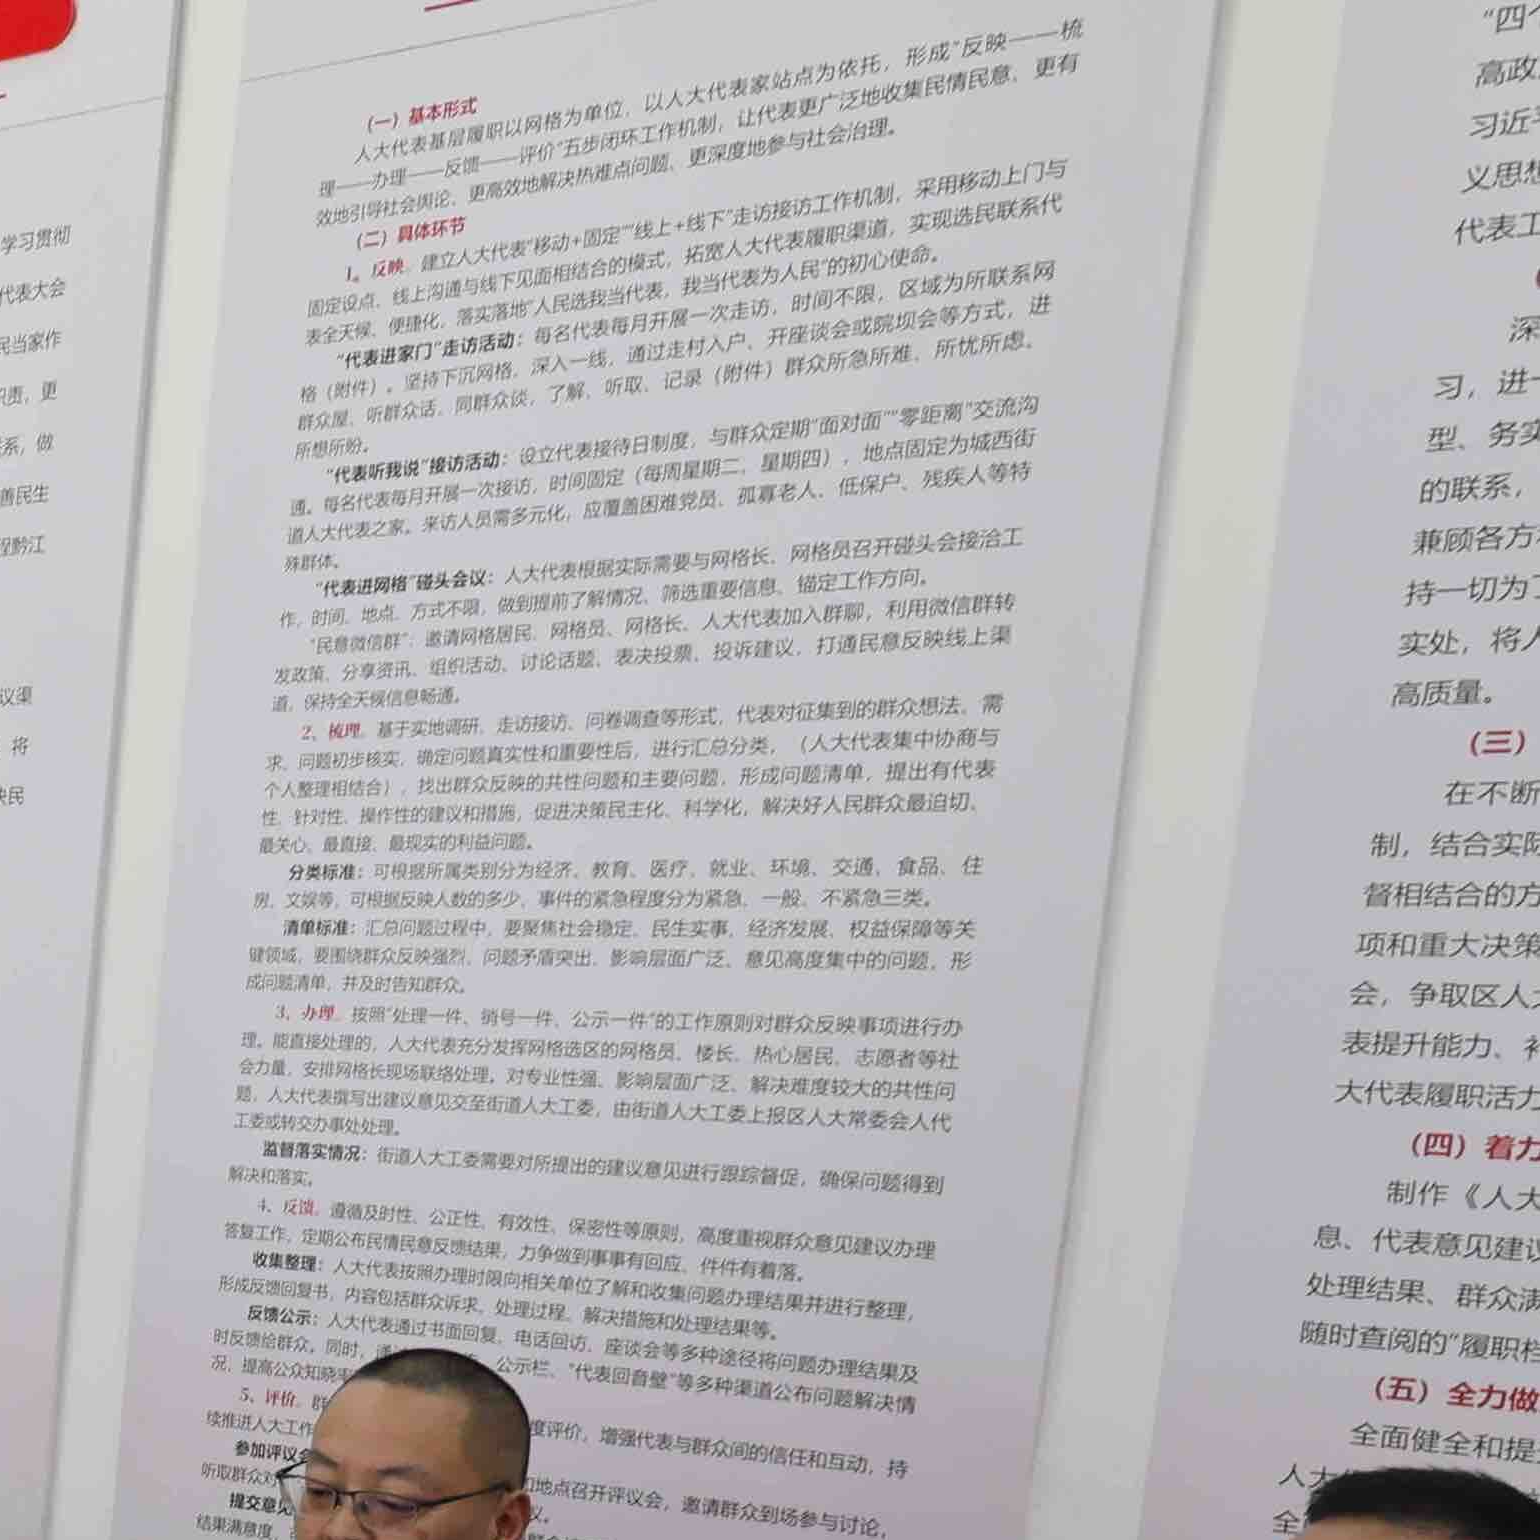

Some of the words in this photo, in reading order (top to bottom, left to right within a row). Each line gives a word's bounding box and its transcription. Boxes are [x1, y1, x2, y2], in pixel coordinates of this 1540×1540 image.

[1475, 56, 1540, 88] 高政
[367, 95, 476, 133] （一）基本形式
[356, 215, 467, 250] （二）具体环节
[1412, 522, 1540, 556] 兼顾各方
[1390, 678, 1492, 708] 高质量。
[1469, 730, 1525, 756] （三）
[1444, 780, 1540, 807] 在不断
[1364, 881, 1540, 910] 督相结合的方
[1354, 931, 1540, 960] 项和重大决策
[1349, 979, 1540, 1010] 会，争取区人
[1332, 1078, 1540, 1113] 大代表履职活力
[1411, 1132, 1540, 1163] （四）着力
[1386, 1178, 1540, 1212] 制作《人大
